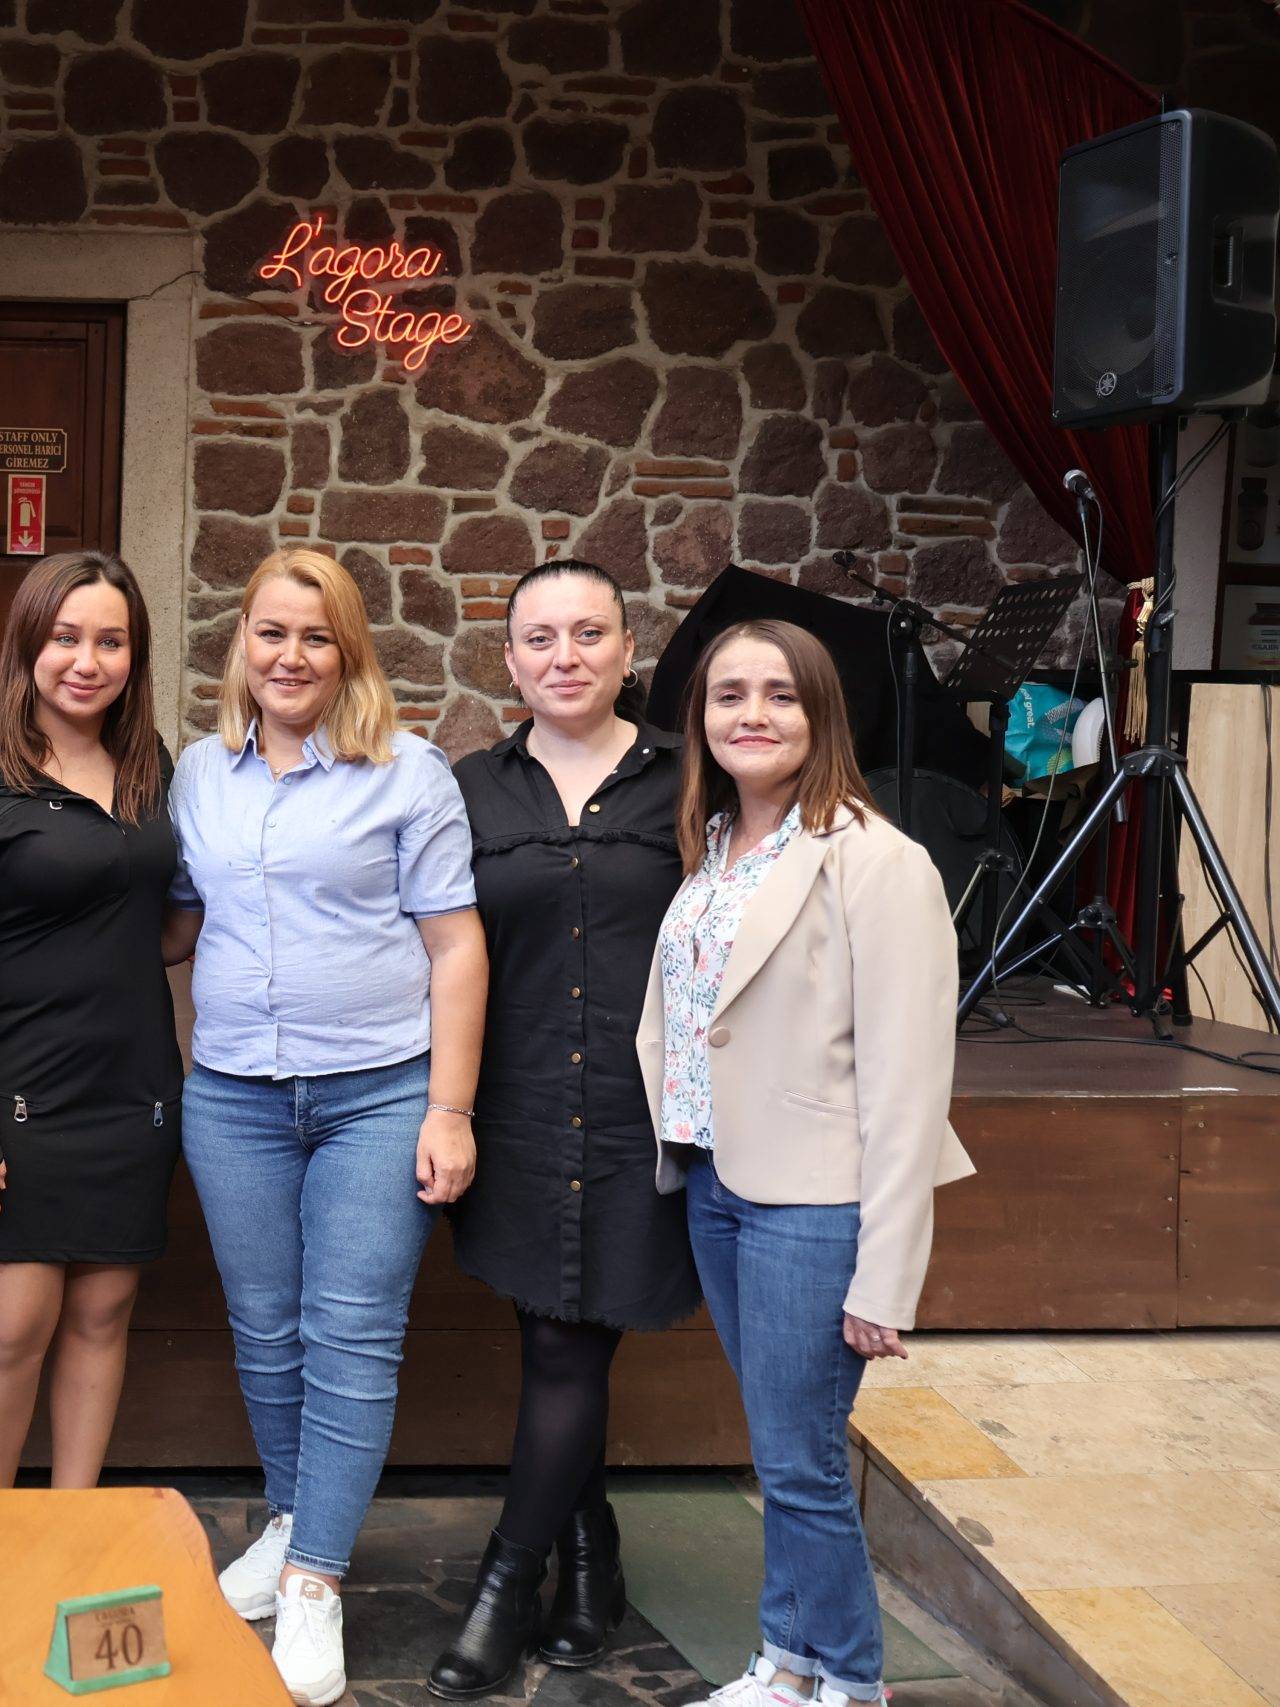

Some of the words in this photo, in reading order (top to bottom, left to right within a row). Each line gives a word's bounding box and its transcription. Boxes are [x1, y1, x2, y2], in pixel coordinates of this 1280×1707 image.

[260, 217, 442, 303] L'agora
[337, 289, 472, 371] Stage
[5, 455, 49, 469] GİREMEZ
[30, 432, 58, 443] ONLY
[94, 1622, 144, 1671] 40
